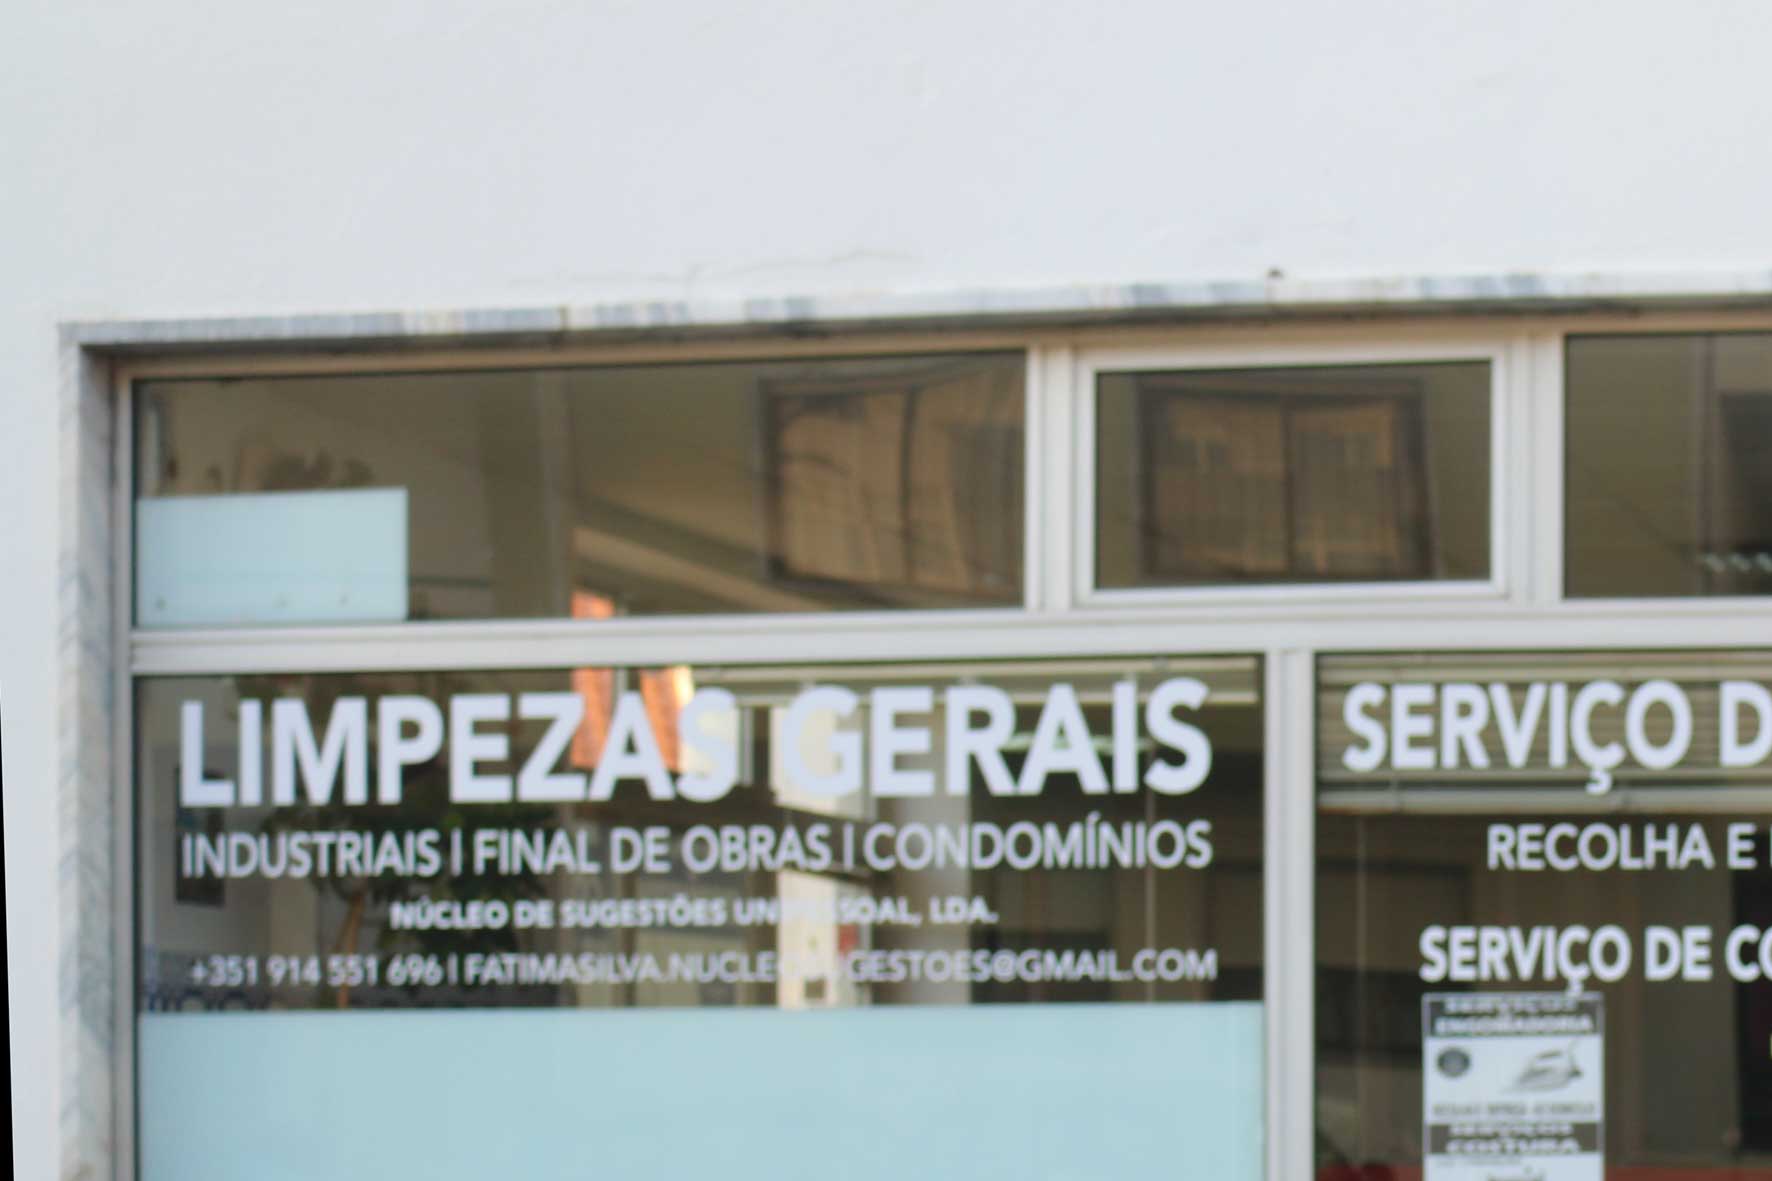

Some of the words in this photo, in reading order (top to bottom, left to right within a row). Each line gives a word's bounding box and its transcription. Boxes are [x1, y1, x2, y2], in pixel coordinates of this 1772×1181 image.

[180, 687, 741, 808] LIMPEZAS
[780, 678, 1213, 800] GERAIS
[1342, 680, 1694, 794] SERVIÇO
[182, 830, 441, 879] INDUSTRIAIS
[472, 828, 600, 875] FINAL
[611, 828, 671, 874] DE
[682, 824, 832, 872] OBRAS
[863, 812, 1213, 869] CONDOMÍNIOS
[1486, 822, 1715, 871] RECOLHA
[1726, 822, 1757, 870] E
[390, 896, 509, 930] NÚCLEO
[514, 899, 554, 928] DE
[560, 892, 727, 928] SUGESTÕES
[929, 895, 998, 924] LDA.
[190, 954, 259, 987] +351
[265, 953, 322, 987] 914
[326, 953, 379, 986] 551
[386, 952, 444, 986] 696
[1419, 925, 1632, 998] SERVIÇO
[1645, 925, 1713, 982] DE
